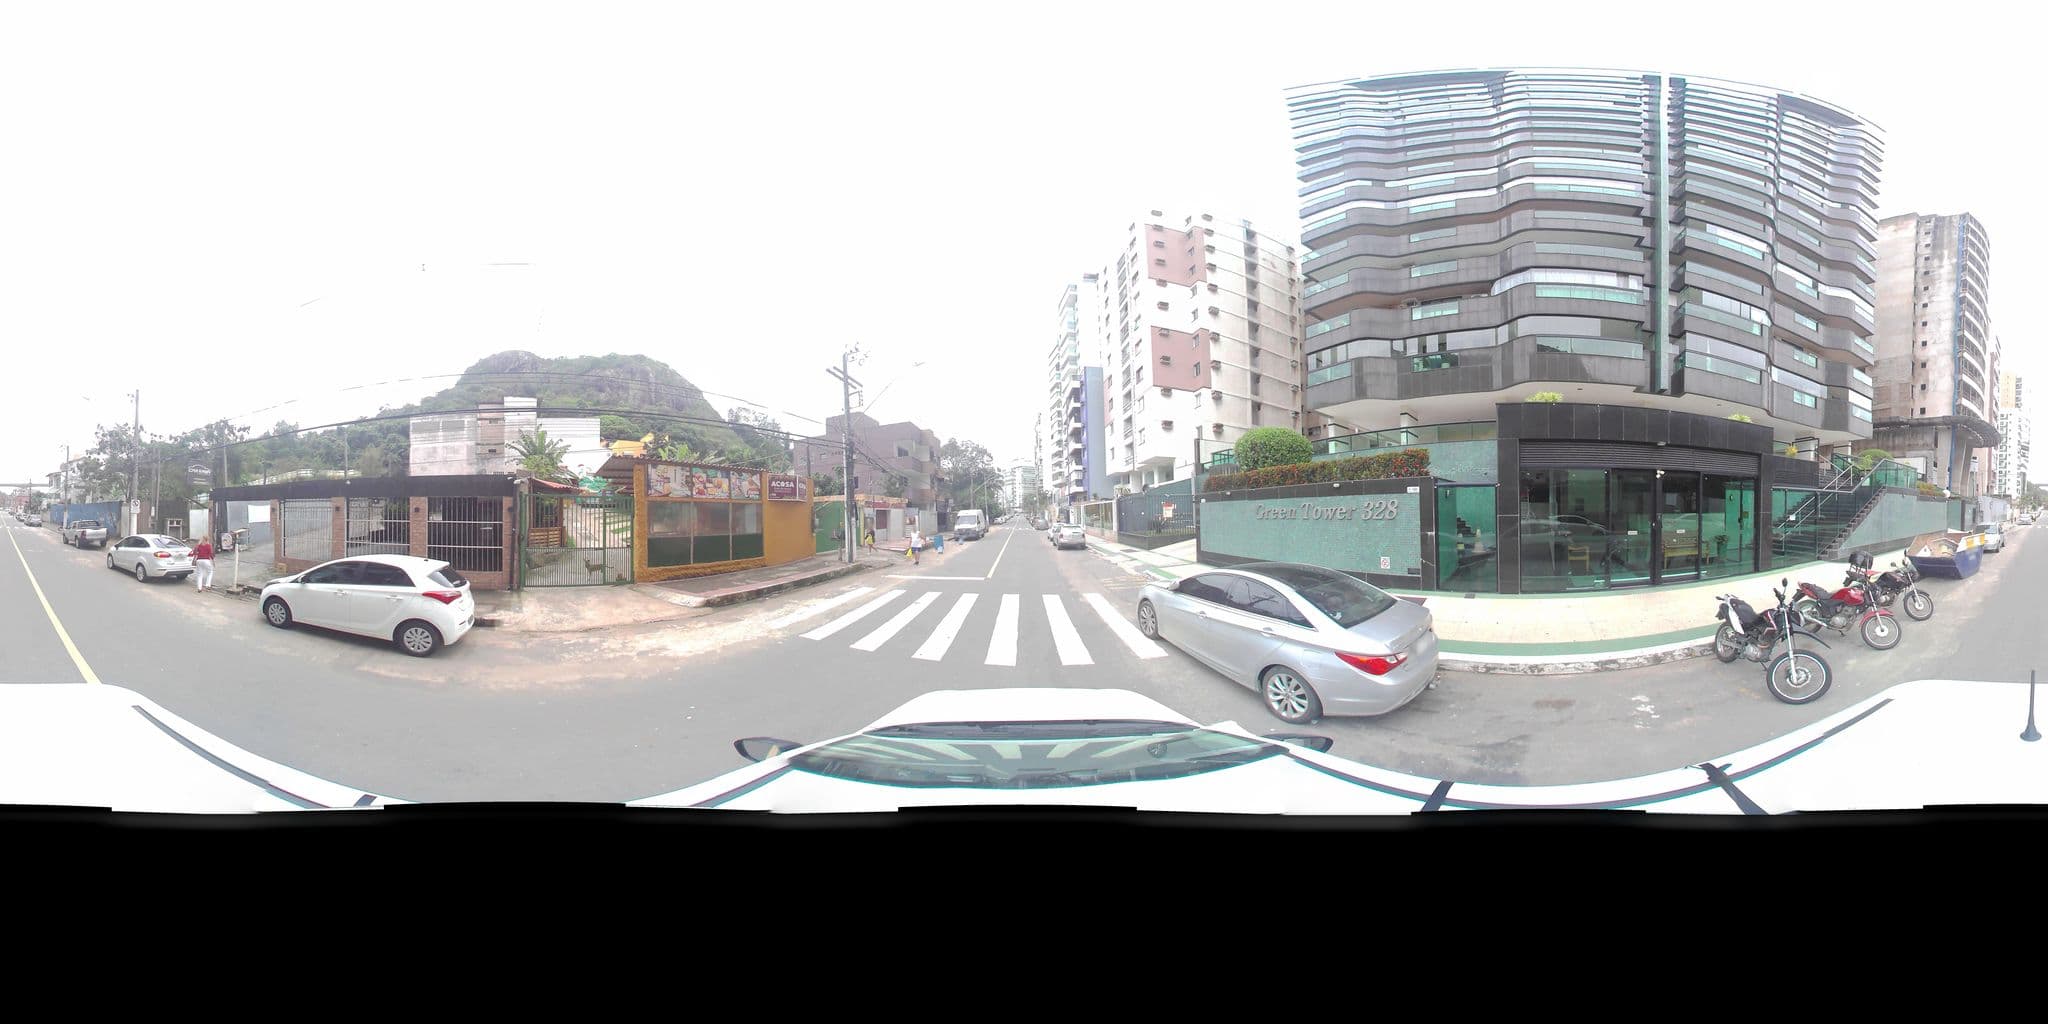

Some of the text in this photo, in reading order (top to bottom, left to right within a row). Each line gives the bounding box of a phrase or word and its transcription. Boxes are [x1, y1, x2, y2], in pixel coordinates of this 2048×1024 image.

[1255, 500, 1399, 520] Green Tower 328
